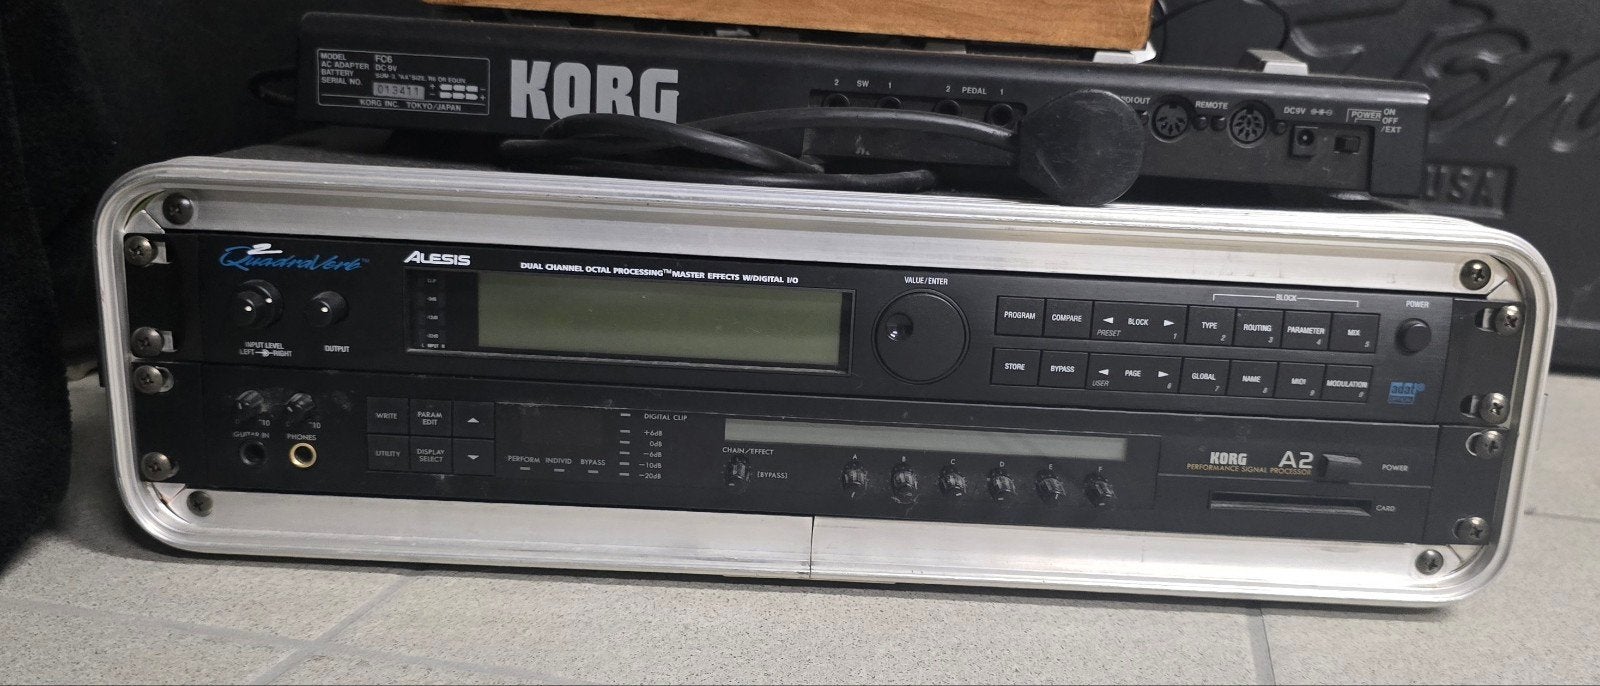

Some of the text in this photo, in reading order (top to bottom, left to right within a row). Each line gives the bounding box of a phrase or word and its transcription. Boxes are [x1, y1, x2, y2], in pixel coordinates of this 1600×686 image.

[320, 52, 393, 63] MODEL FC6
[321, 60, 332, 68] AC
[334, 62, 370, 70] ADAPTER
[321, 69, 354, 77] BATTERY
[321, 77, 347, 85] SERIAL
[834, 78, 840, 86] 2
[856, 80, 869, 88] SW
[510, 60, 679, 124] KORG
[945, 85, 951, 93] 2
[961, 86, 987, 95] PEDAL
[1134, 96, 1151, 105] OUT
[1195, 100, 1228, 110] REMOTE
[406, 102, 461, 112] TOKYO/JAPAN
[1283, 106, 1306, 115] DC9V
[1383, 107, 1396, 116] ON
[1351, 110, 1381, 120] POWER
[1381, 116, 1399, 125] OFF
[404, 250, 471, 266] ALESIS
[520, 261, 543, 271] DUAL
[545, 263, 584, 273] CHANNEL
[585, 265, 611, 275] OCTAL
[672, 270, 705, 280] MASTER
[707, 272, 740, 282] EFFECTS
[742, 274, 784, 284] W/DIGITAL
[786, 276, 799, 285] I/O
[904, 276, 949, 285] VALUE/ENTER
[1276, 293, 1297, 303] BLOCK
[1406, 300, 1430, 309] POWER
[1004, 310, 1036, 320] PROGRAM
[1051, 313, 1082, 323] COMPARE
[1127, 317, 1149, 326] BLOCK
[1201, 321, 1218, 330] TYPE
[1096, 328, 1121, 337] PRESET
[1243, 323, 1272, 333] ROUTING
[1287, 326, 1325, 335] PARAMETER
[1220, 334, 1226, 342] 2
[1268, 336, 1274, 344] 3
[1315, 338, 1322, 346] 4
[245, 341, 284, 351] INPUT LEVEL
[324, 344, 350, 353] OUTPUT
[272, 350, 293, 358] RIGHT
[1004, 362, 1026, 371] STORE
[1050, 365, 1075, 373] BYPASS
[1124, 369, 1142, 378] PAGE
[1191, 372, 1216, 381] GLOBAL
[1242, 374, 1261, 383] NAME
[1092, 379, 1110, 388] USER
[1214, 384, 1220, 392] 7
[1326, 379, 1368, 389] MODULATION
[375, 412, 398, 420] WRITE
[417, 410, 443, 419] PARAM
[644, 412, 671, 421] DIGITAL
[422, 418, 440, 426] EDIT
[261, 431, 270, 439] IN
[286, 433, 317, 441] PHONES
[643, 429, 663, 438] +6dB
[649, 440, 663, 448] 0dB
[375, 449, 400, 458] UTILITY
[416, 448, 445, 457] DISPLAY
[722, 446, 774, 456] CHAIN/EFFECT
[419, 455, 443, 464] SELECT
[507, 454, 541, 464] PERFORM
[545, 457, 572, 465] INDIVID
[580, 458, 606, 467] BYPASS
[950, 458, 956, 466] C
[1209, 450, 1248, 466] KORG
[1277, 450, 1314, 468] A2
[1000, 460, 1005, 468] D
[1382, 463, 1408, 473] POWER
[1186, 463, 1312, 477] PERFORMANCE SIGNAL PROCESSOR
[757, 470, 788, 480] [BYPASS]
[1375, 504, 1396, 513] CARD
